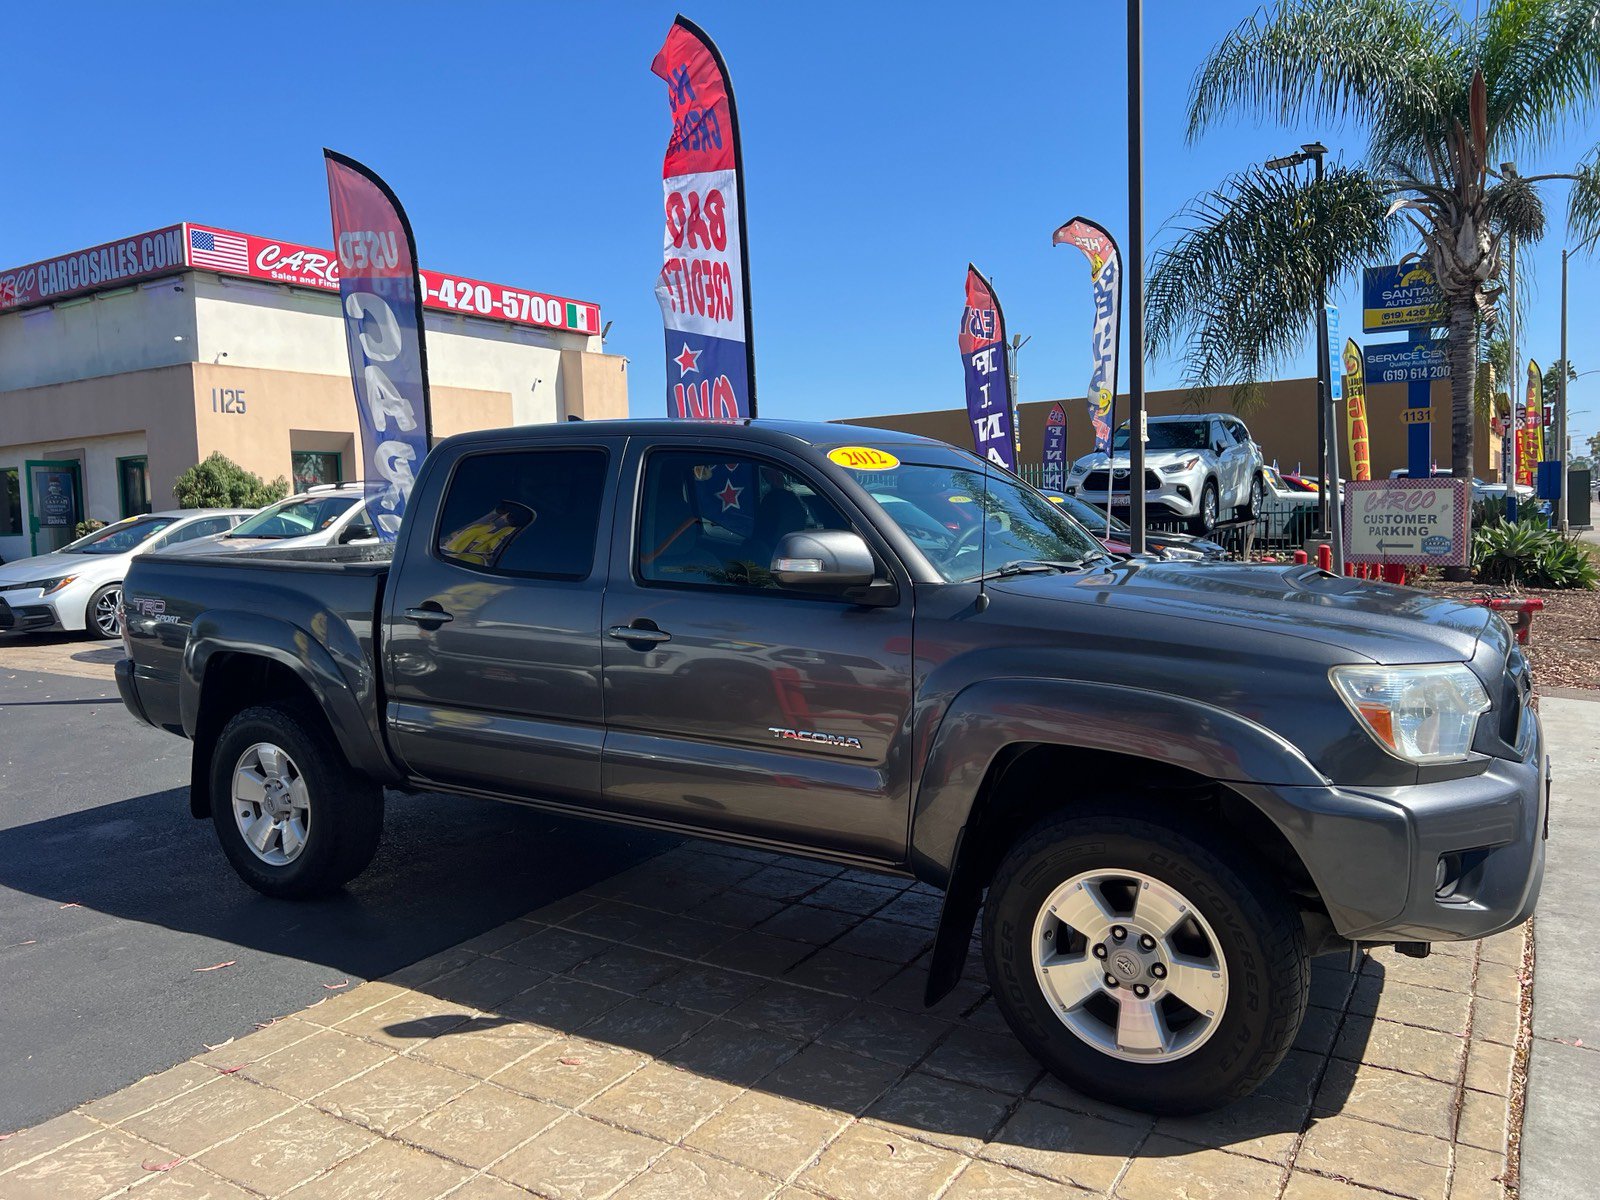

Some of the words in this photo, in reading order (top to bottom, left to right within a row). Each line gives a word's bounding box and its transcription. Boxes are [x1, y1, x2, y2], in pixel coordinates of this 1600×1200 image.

[37, 229, 183, 297] CARCOSALES.COM
[255, 245, 340, 282] CARC
[271, 270, 297, 282] Sales
[299, 276, 316, 285] and
[1385, 298, 1413, 307] AUTO
[1381, 310, 1404, 320] (619)
[1367, 351, 1420, 363] SERVICE
[1389, 360, 1411, 368] Quality
[1382, 368, 1408, 382] (619)
[1410, 366, 1428, 379] 614
[1430, 365, 1451, 378] 200
[212, 388, 247, 414] 1125
[1403, 410, 1431, 422] 1131
[841, 450, 887, 466] 2012
[1363, 490, 1437, 513] CARCO
[1363, 514, 1438, 525] CUSTOMER
[1369, 526, 1429, 537] PARKING
[133, 597, 166, 617] TRD
[154, 614, 181, 624] SPORT
[768, 727, 863, 749] TACOMA
[1147, 852, 1259, 1012] DISCOVERER
